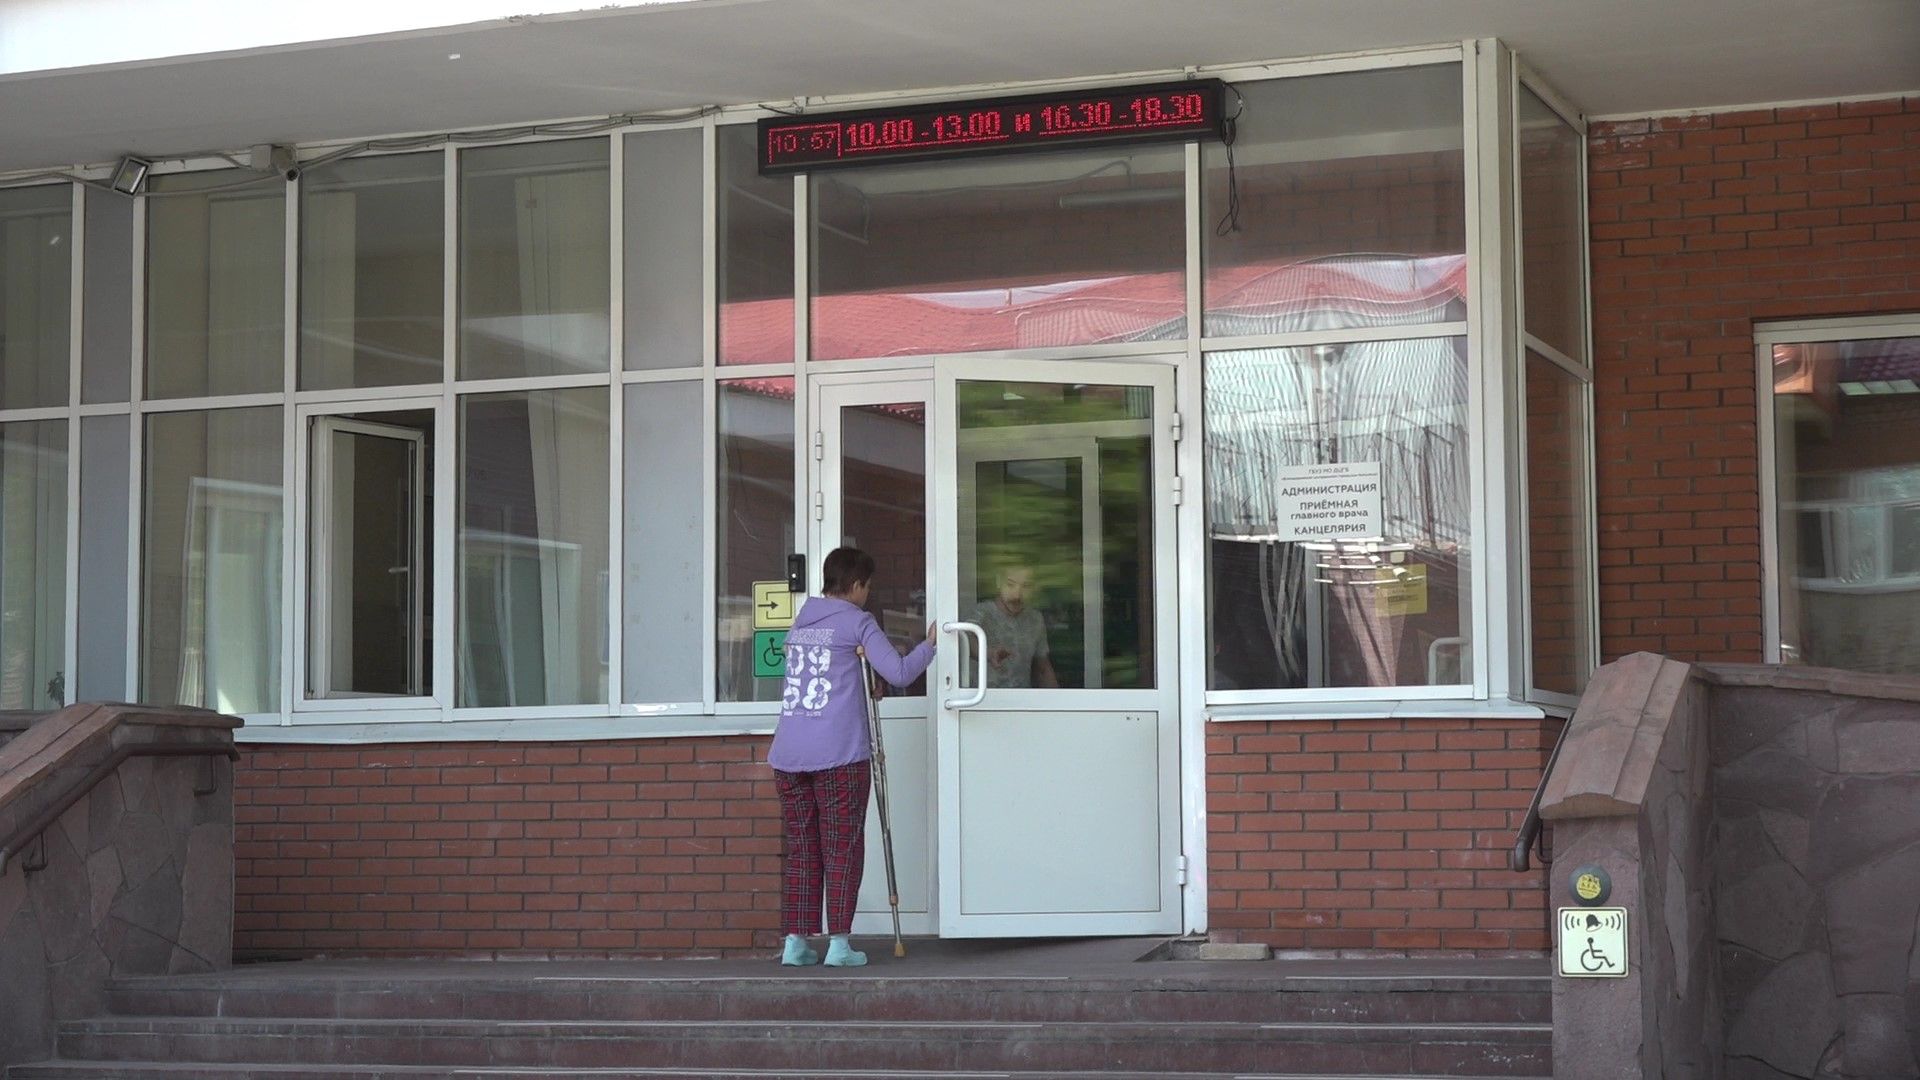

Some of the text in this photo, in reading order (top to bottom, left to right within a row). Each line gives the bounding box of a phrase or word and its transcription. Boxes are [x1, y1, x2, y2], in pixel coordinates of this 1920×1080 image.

[1014, 113, 1031, 132] и
[772, 131, 836, 152] 10:57
[1281, 483, 1377, 497] АДМИНИСТРАЦИЯ
[1300, 499, 1359, 511] ПРИЁМНАЯ
[1290, 510, 1369, 521] главного врача
[1294, 524, 1366, 535] КАНЦЕЛЯРИЯ
